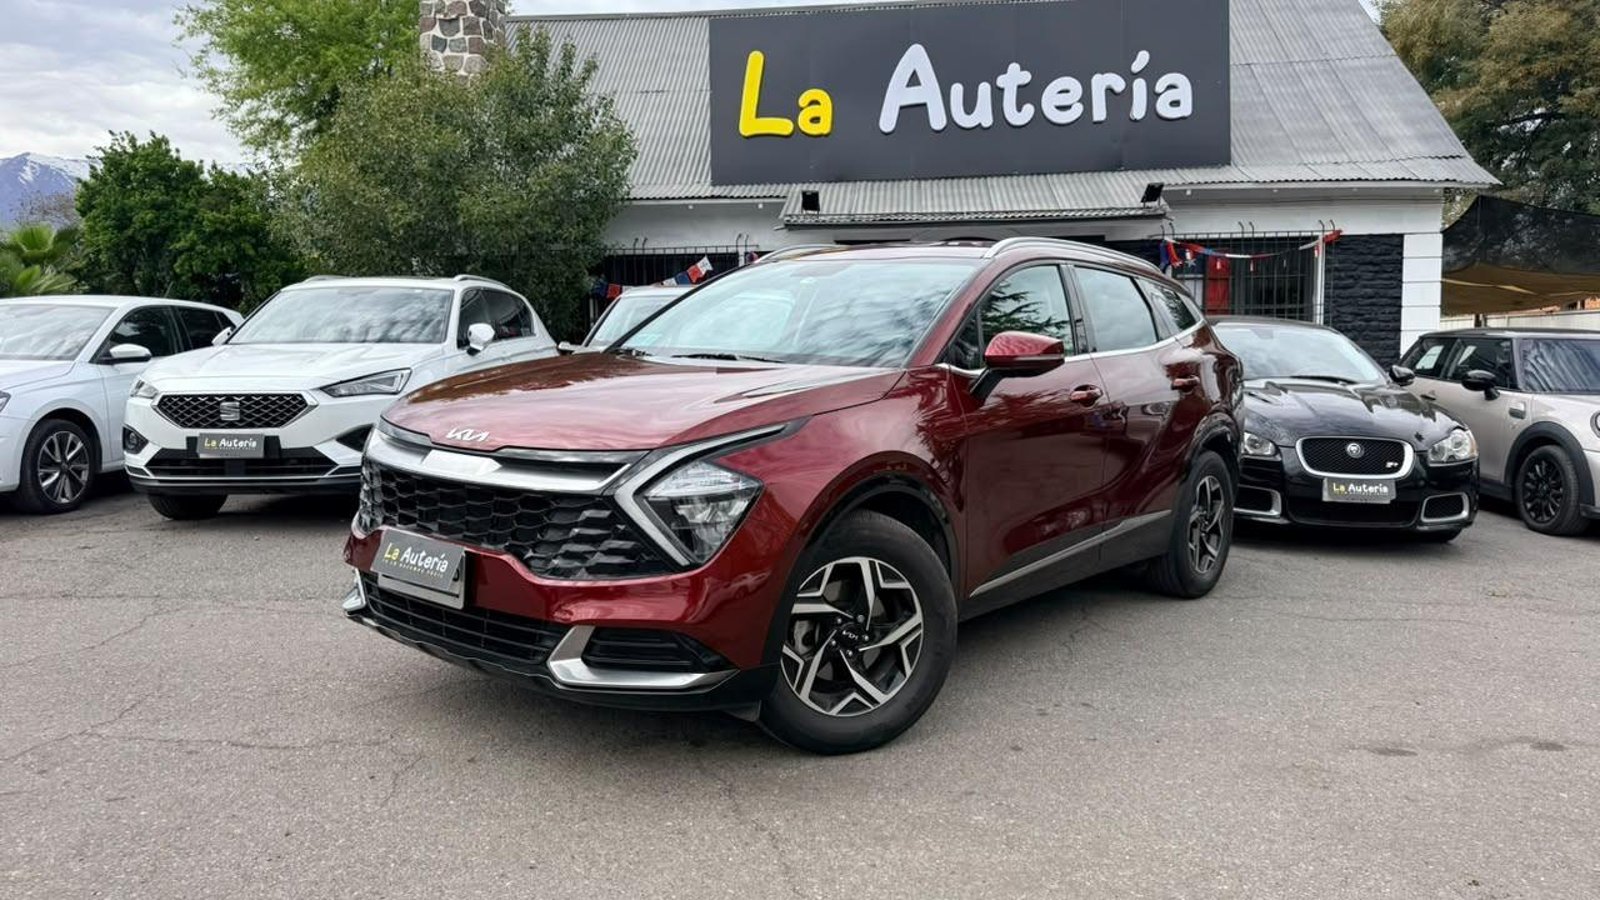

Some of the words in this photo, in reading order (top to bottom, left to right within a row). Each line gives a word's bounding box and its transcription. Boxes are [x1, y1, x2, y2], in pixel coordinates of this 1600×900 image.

[738, 50, 833, 138] La
[878, 43, 1194, 134] Autería
[384, 542, 400, 560] La
[400, 546, 448, 573] Autería
